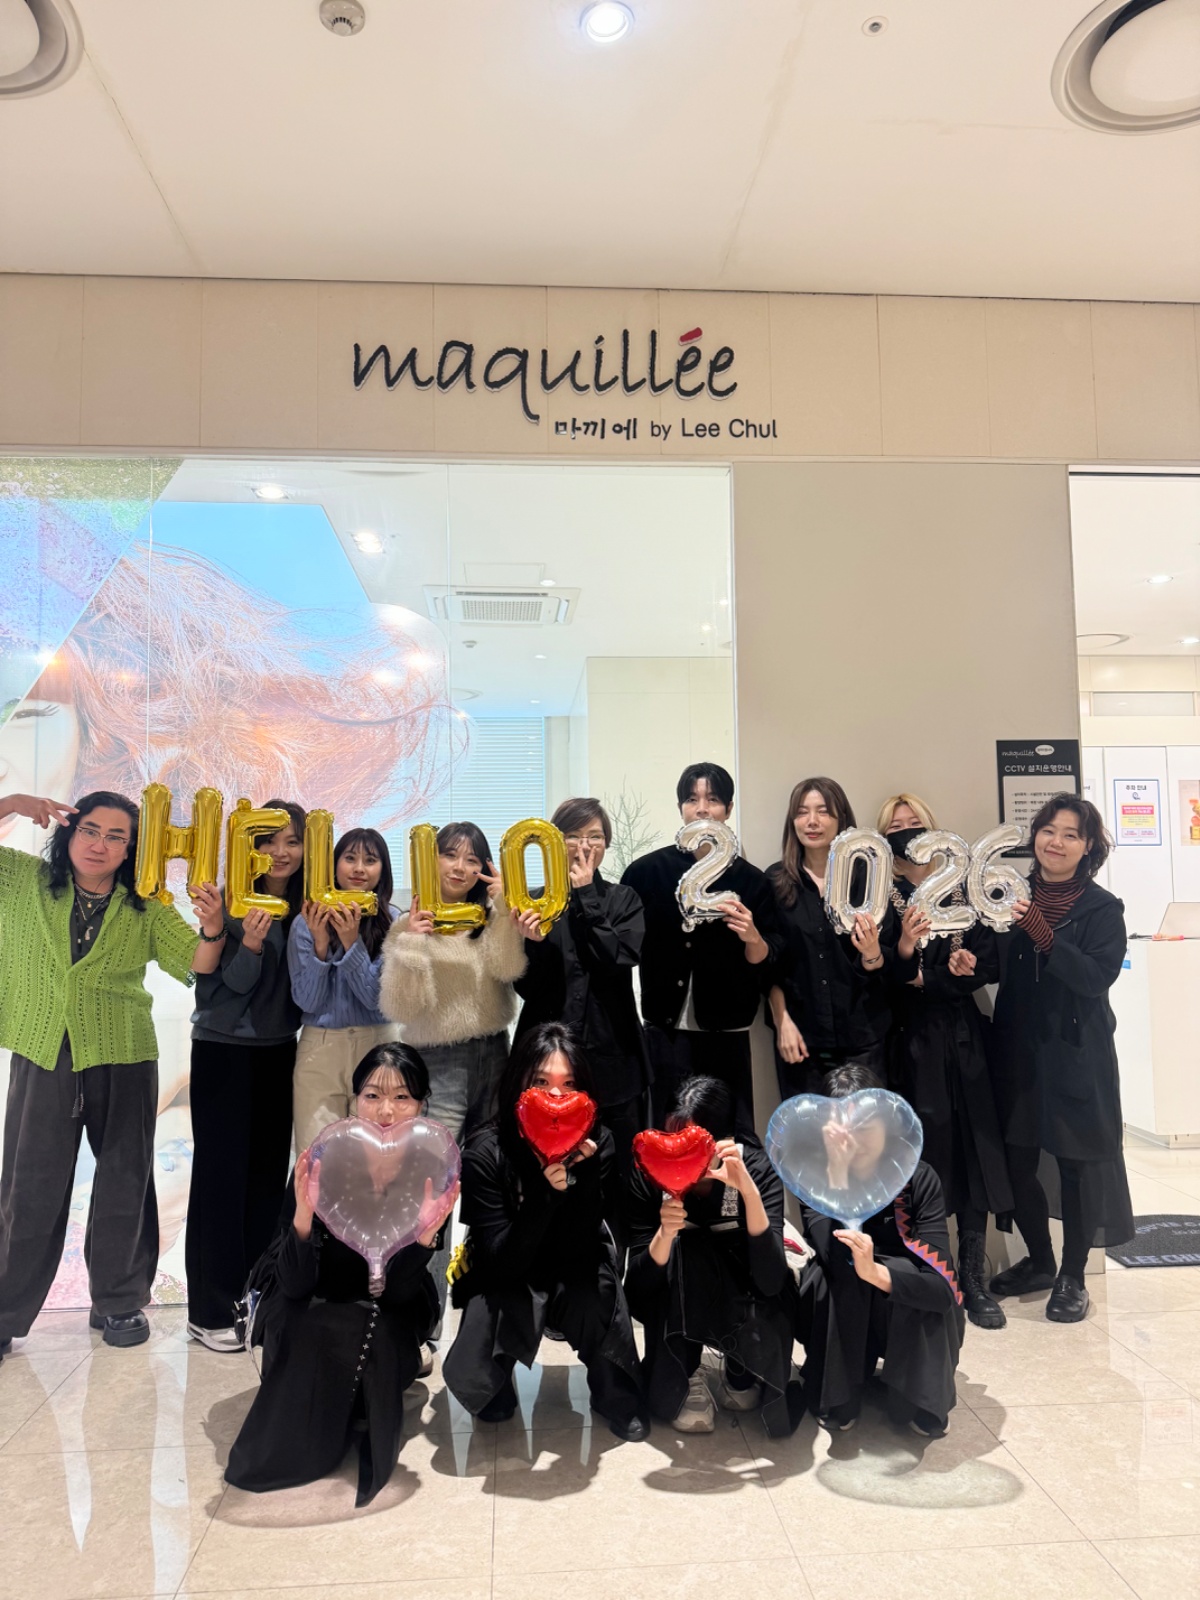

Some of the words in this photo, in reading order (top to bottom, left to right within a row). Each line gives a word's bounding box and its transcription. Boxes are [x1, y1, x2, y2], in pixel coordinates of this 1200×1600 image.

[353, 327, 738, 424] maquillée
[554, 417, 638, 440] 마끼에
[650, 420, 672, 441] by
[681, 417, 721, 438] Lee
[728, 418, 778, 438] Chul
[1004, 764, 1026, 773] CCTV
